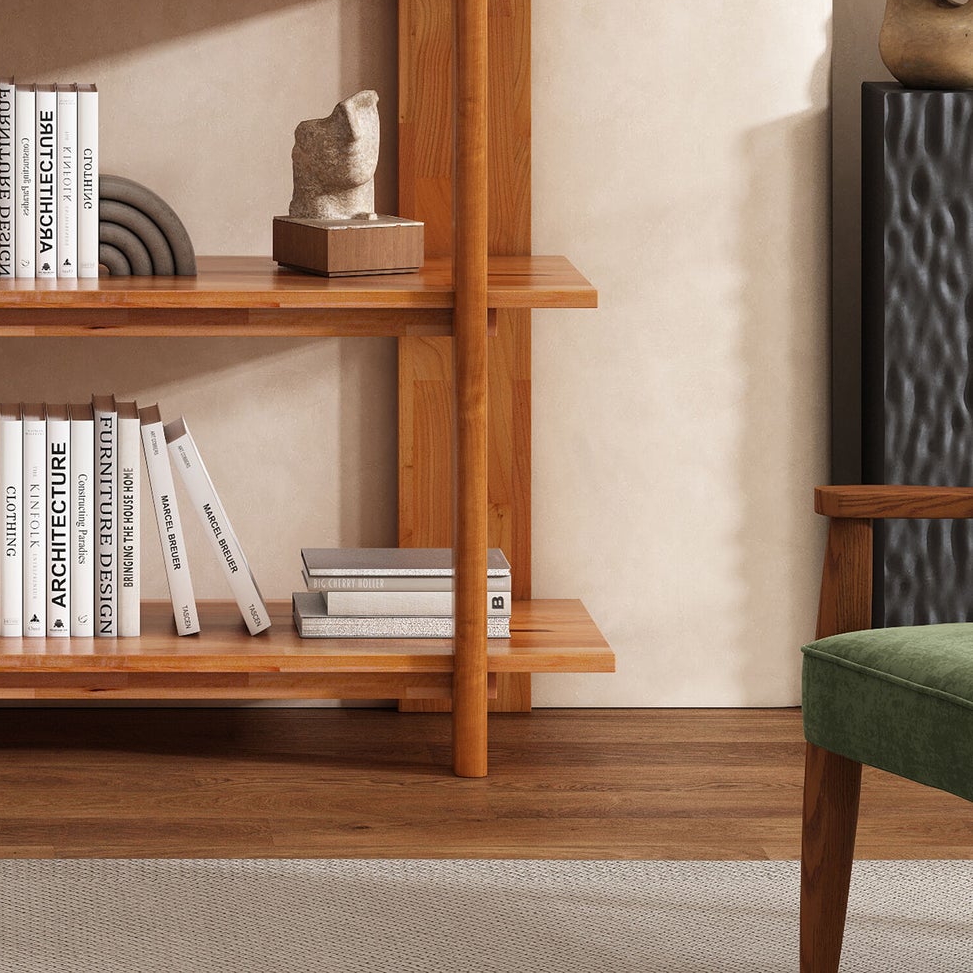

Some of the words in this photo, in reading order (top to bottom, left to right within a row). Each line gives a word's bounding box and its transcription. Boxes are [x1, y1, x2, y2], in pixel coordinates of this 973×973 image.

[99, 417, 113, 546] FURNITURE
[123, 467, 133, 491] HOME
[29, 483, 40, 549] KINFOLK
[76, 473, 88, 527] Constructing
[123, 492, 133, 523] HOUSE
[161, 495, 175, 533] MARCEL
[6, 485, 17, 557] CLOTHING
[51, 443, 67, 608] ARCHITECTURE
[123, 523, 133, 543] THE
[203, 503, 221, 539] MARCEL
[219, 539, 239, 574] BREUER
[123, 545, 133, 587] BRINGING
[167, 533, 181, 571] BREUER
[99, 553, 113, 635] DESIGN
[313, 579, 326, 589] BIG
[328, 579, 356, 588] CHERRY
[491, 595, 505, 609] B
[181, 605, 192, 629] TASCEN
[249, 603, 263, 628] TASCEN
